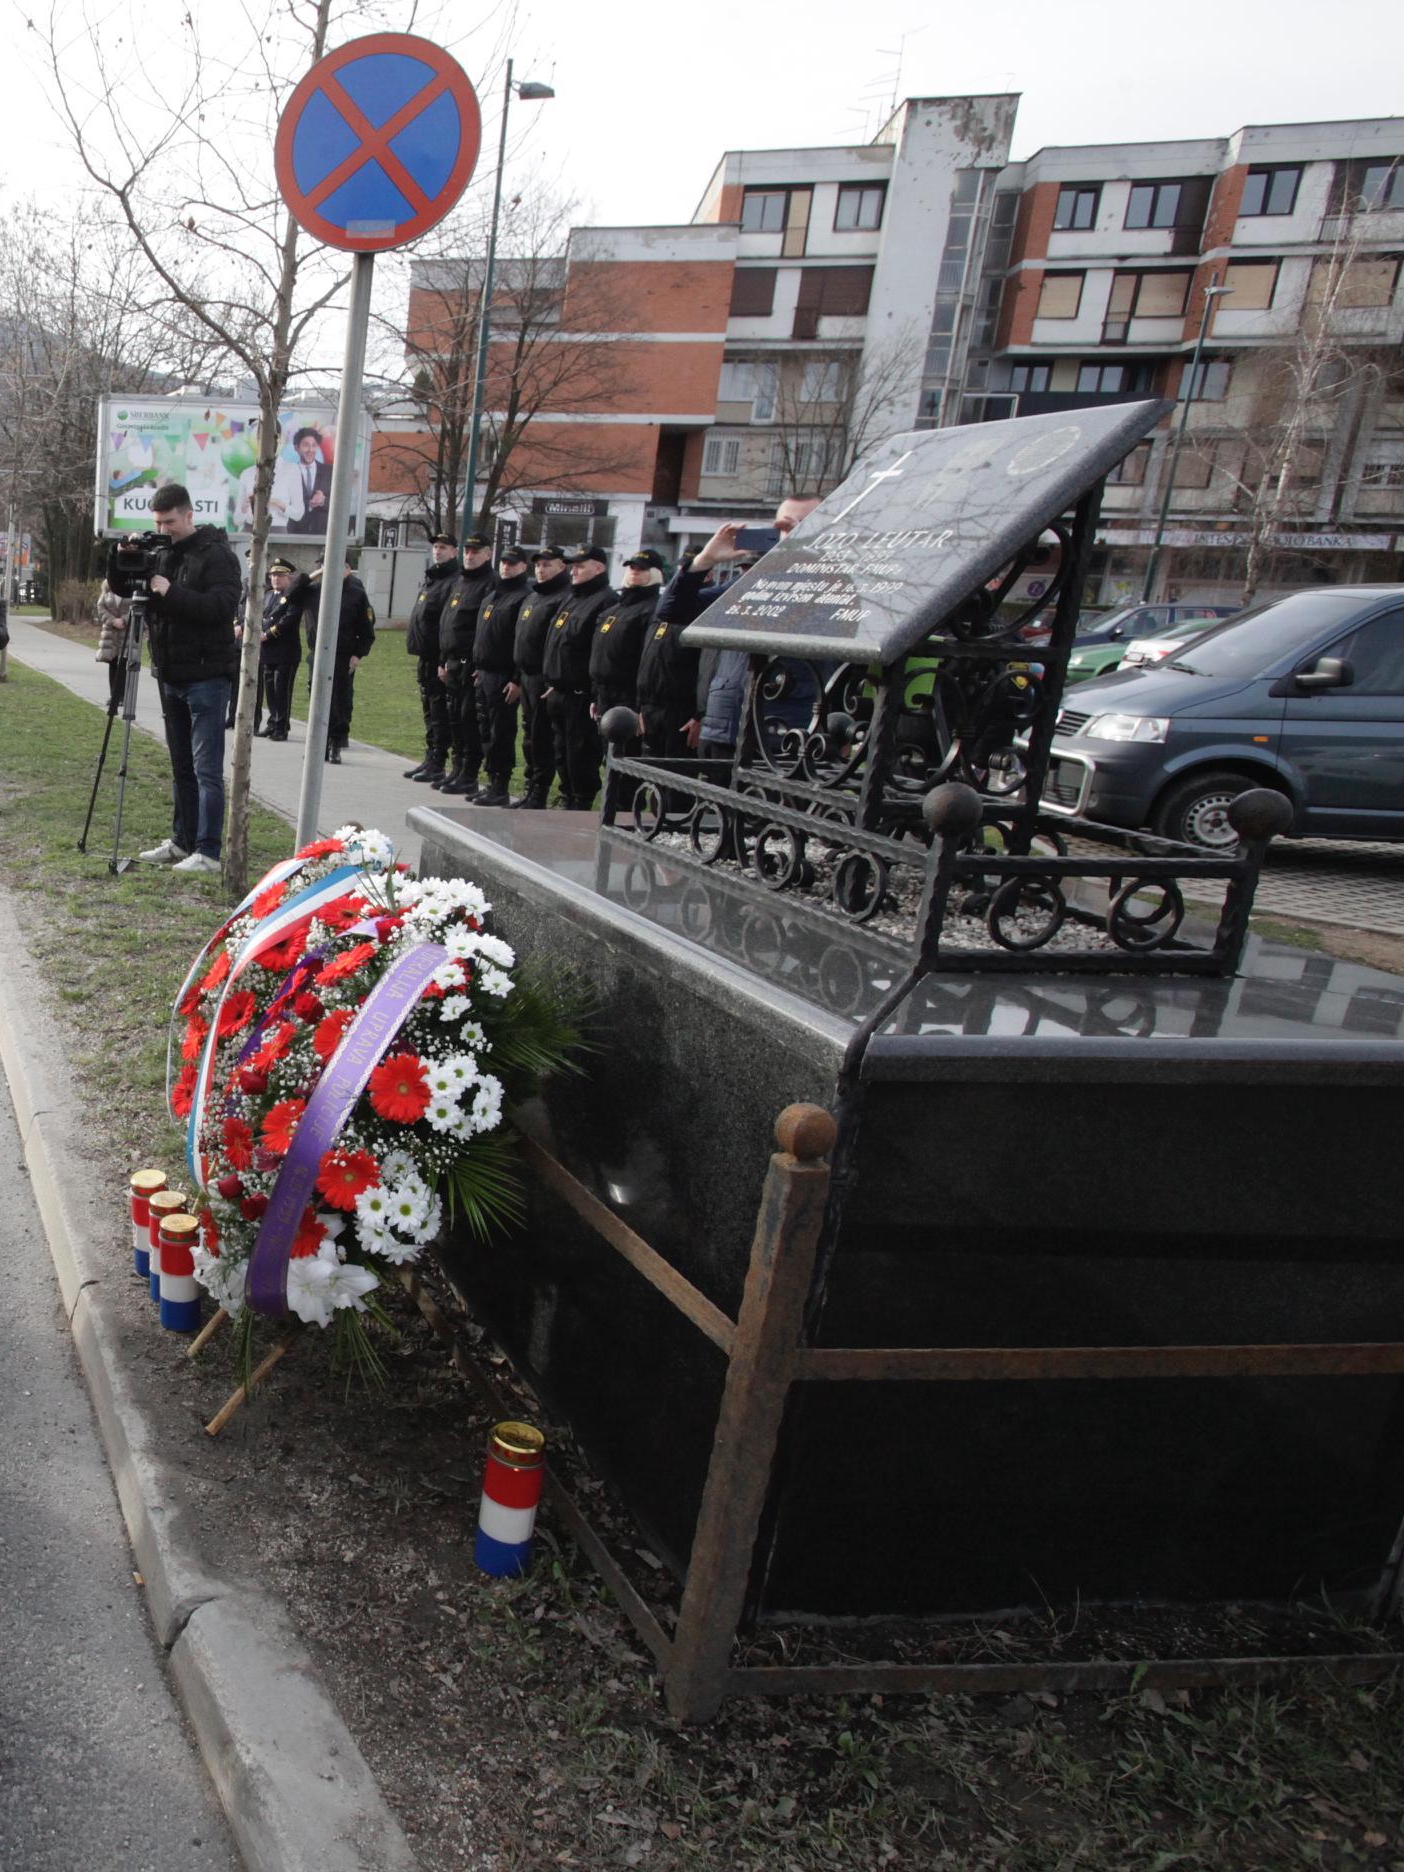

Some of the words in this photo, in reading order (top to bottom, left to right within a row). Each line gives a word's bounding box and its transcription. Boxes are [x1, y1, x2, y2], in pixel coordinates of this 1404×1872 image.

[802, 532, 858, 549] JOZO
[861, 529, 954, 549] LEUTAR
[752, 604, 787, 617] 2002
[345, 1010, 390, 1067] UPRAVA
